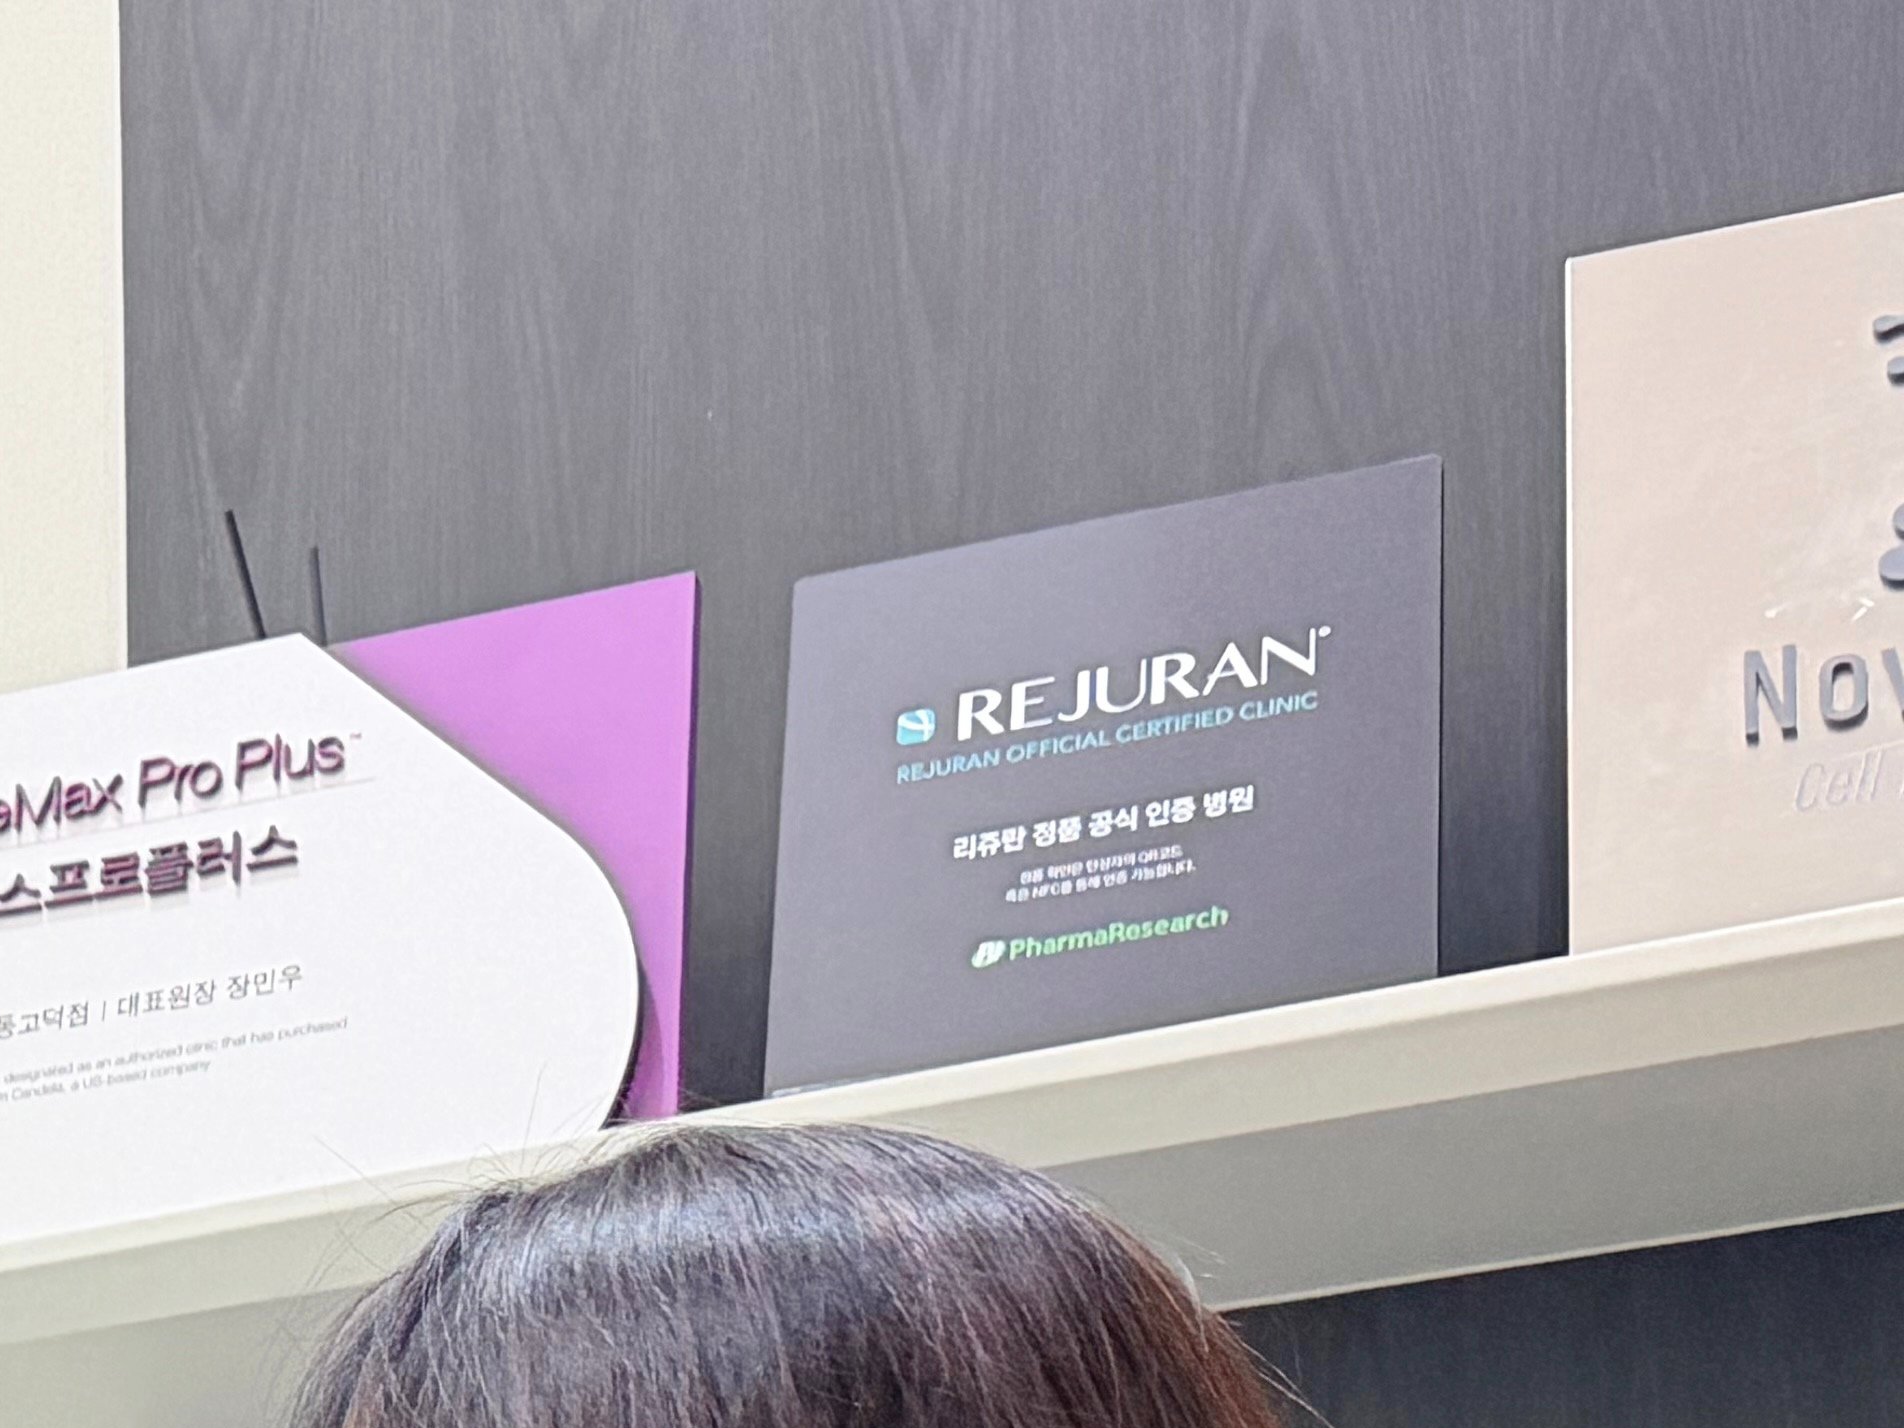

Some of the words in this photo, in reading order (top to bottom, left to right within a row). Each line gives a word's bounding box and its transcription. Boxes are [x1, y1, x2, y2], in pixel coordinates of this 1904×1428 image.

[957, 627, 1318, 741] REJURAN
[897, 748, 1001, 784] REJURAN
[1006, 730, 1111, 763] OFFICIAL
[1116, 706, 1234, 744] CERTIFIED
[1239, 691, 1319, 721] CLINIC
[138, 757, 223, 808] Pro
[1089, 805, 1139, 838] 공식
[1146, 796, 1196, 827] 인증
[1203, 784, 1255, 818] 병원
[117, 979, 217, 1018] 대표원장
[226, 965, 304, 1001] 장민우
